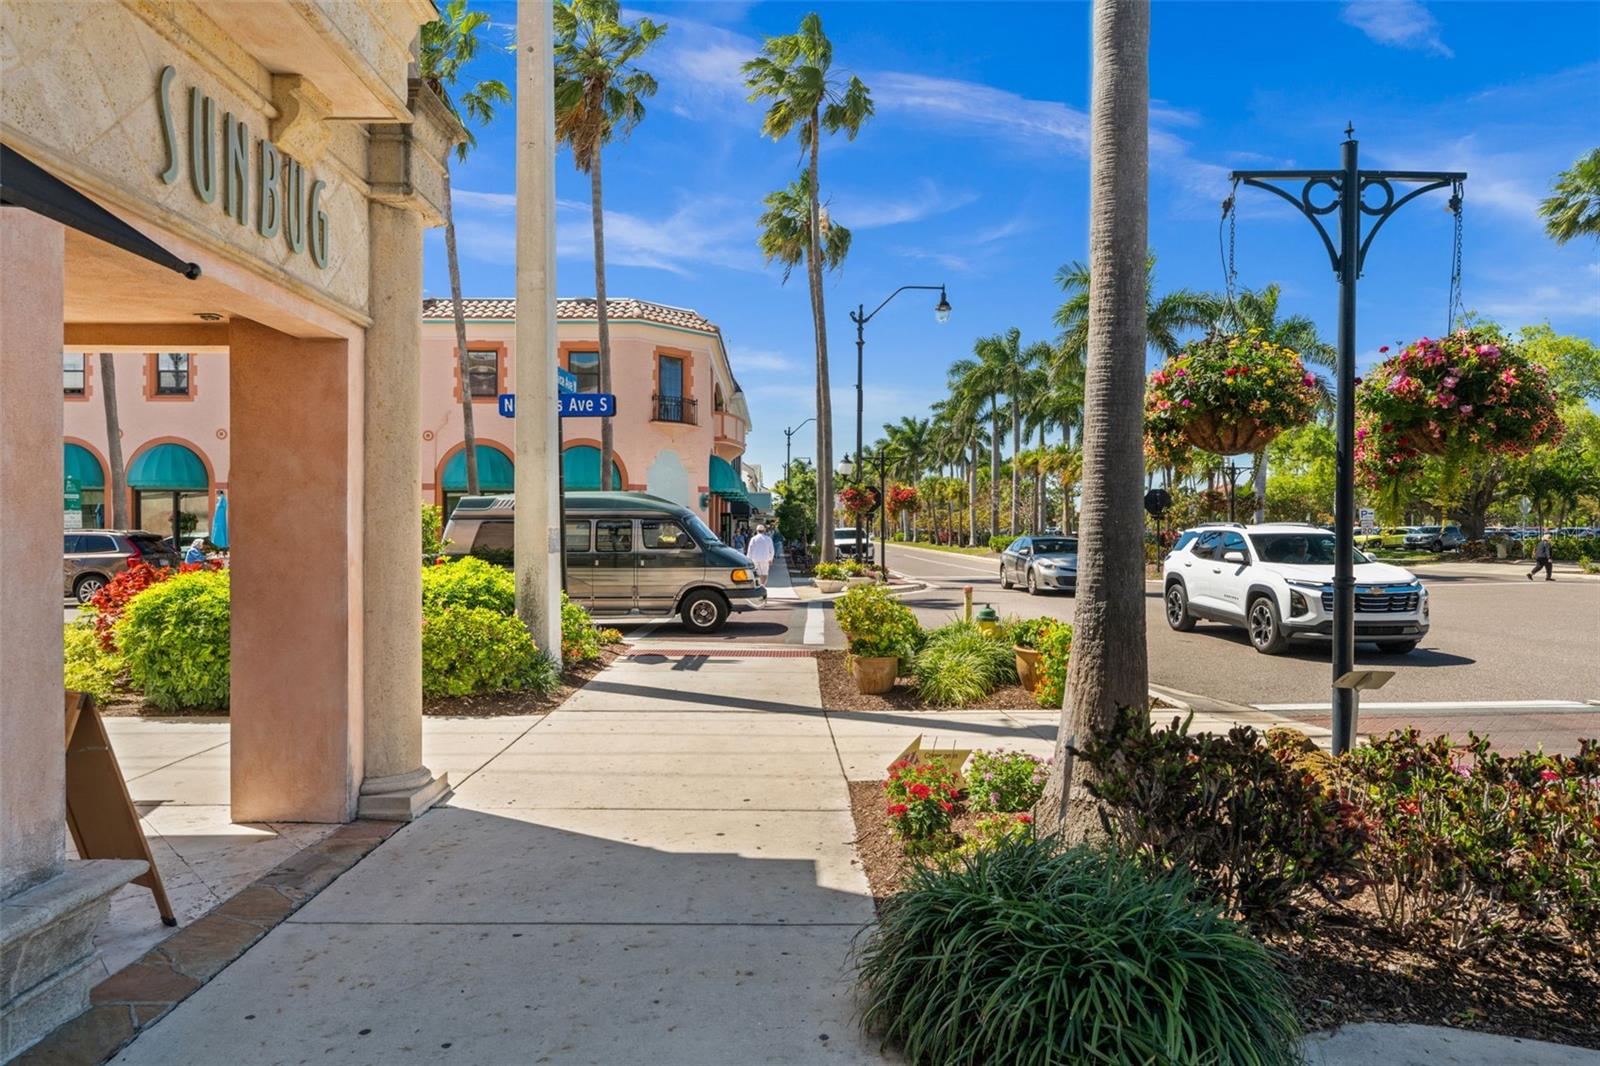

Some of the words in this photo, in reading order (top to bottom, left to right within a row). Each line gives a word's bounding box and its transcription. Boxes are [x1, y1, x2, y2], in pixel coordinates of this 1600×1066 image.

[159, 65, 329, 270] SUNBUG
[569, 398, 593, 411] Ave
[600, 397, 608, 411] S
[1361, 510, 1368, 518] P
